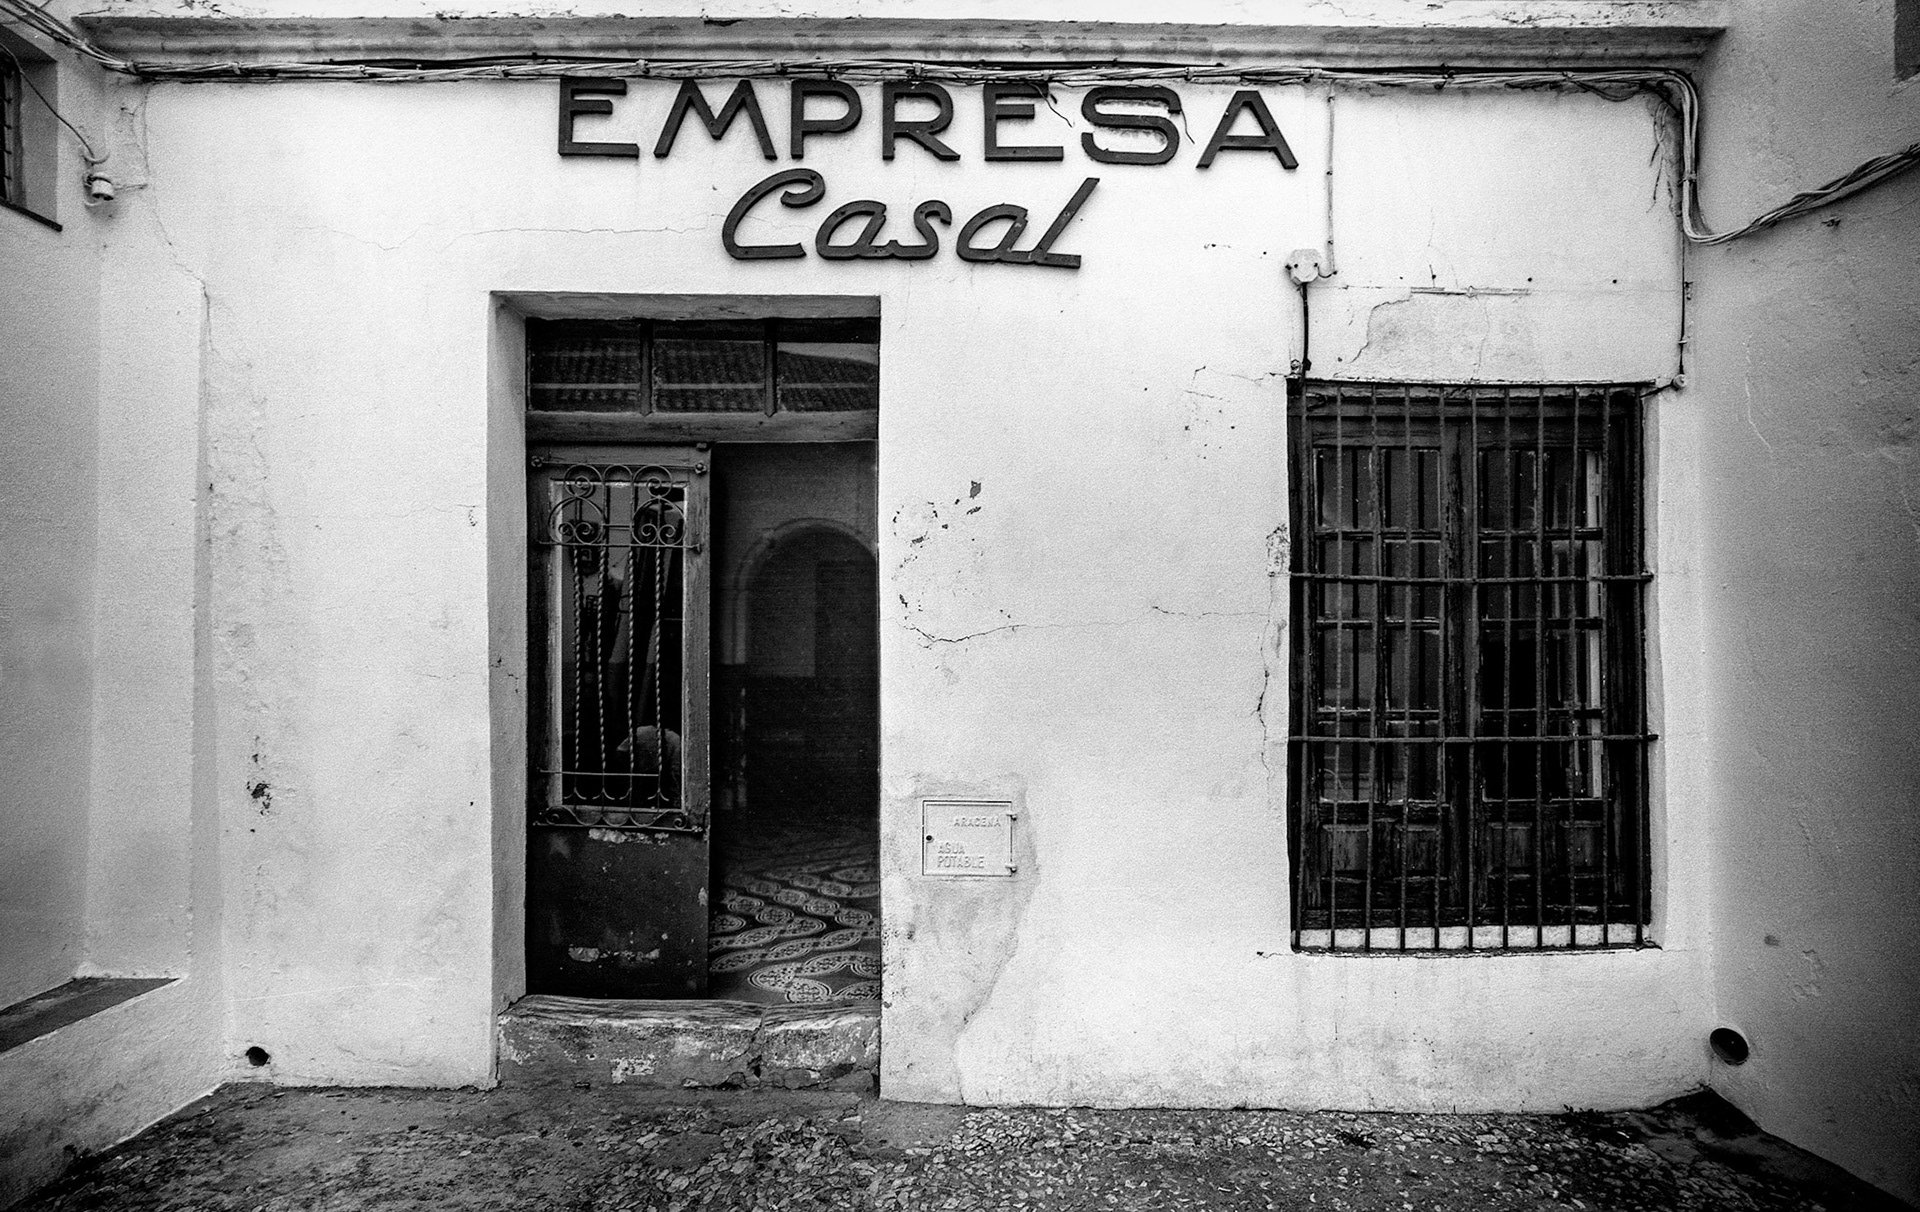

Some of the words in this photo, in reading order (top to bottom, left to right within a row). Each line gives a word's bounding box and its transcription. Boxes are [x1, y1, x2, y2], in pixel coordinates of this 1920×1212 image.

[558, 77, 1299, 170] EMPRESA
[722, 168, 1100, 271] Casal
[953, 816, 1001, 827] ARACENA
[937, 842, 965, 854] AGUA
[937, 855, 985, 868] POTABLE
